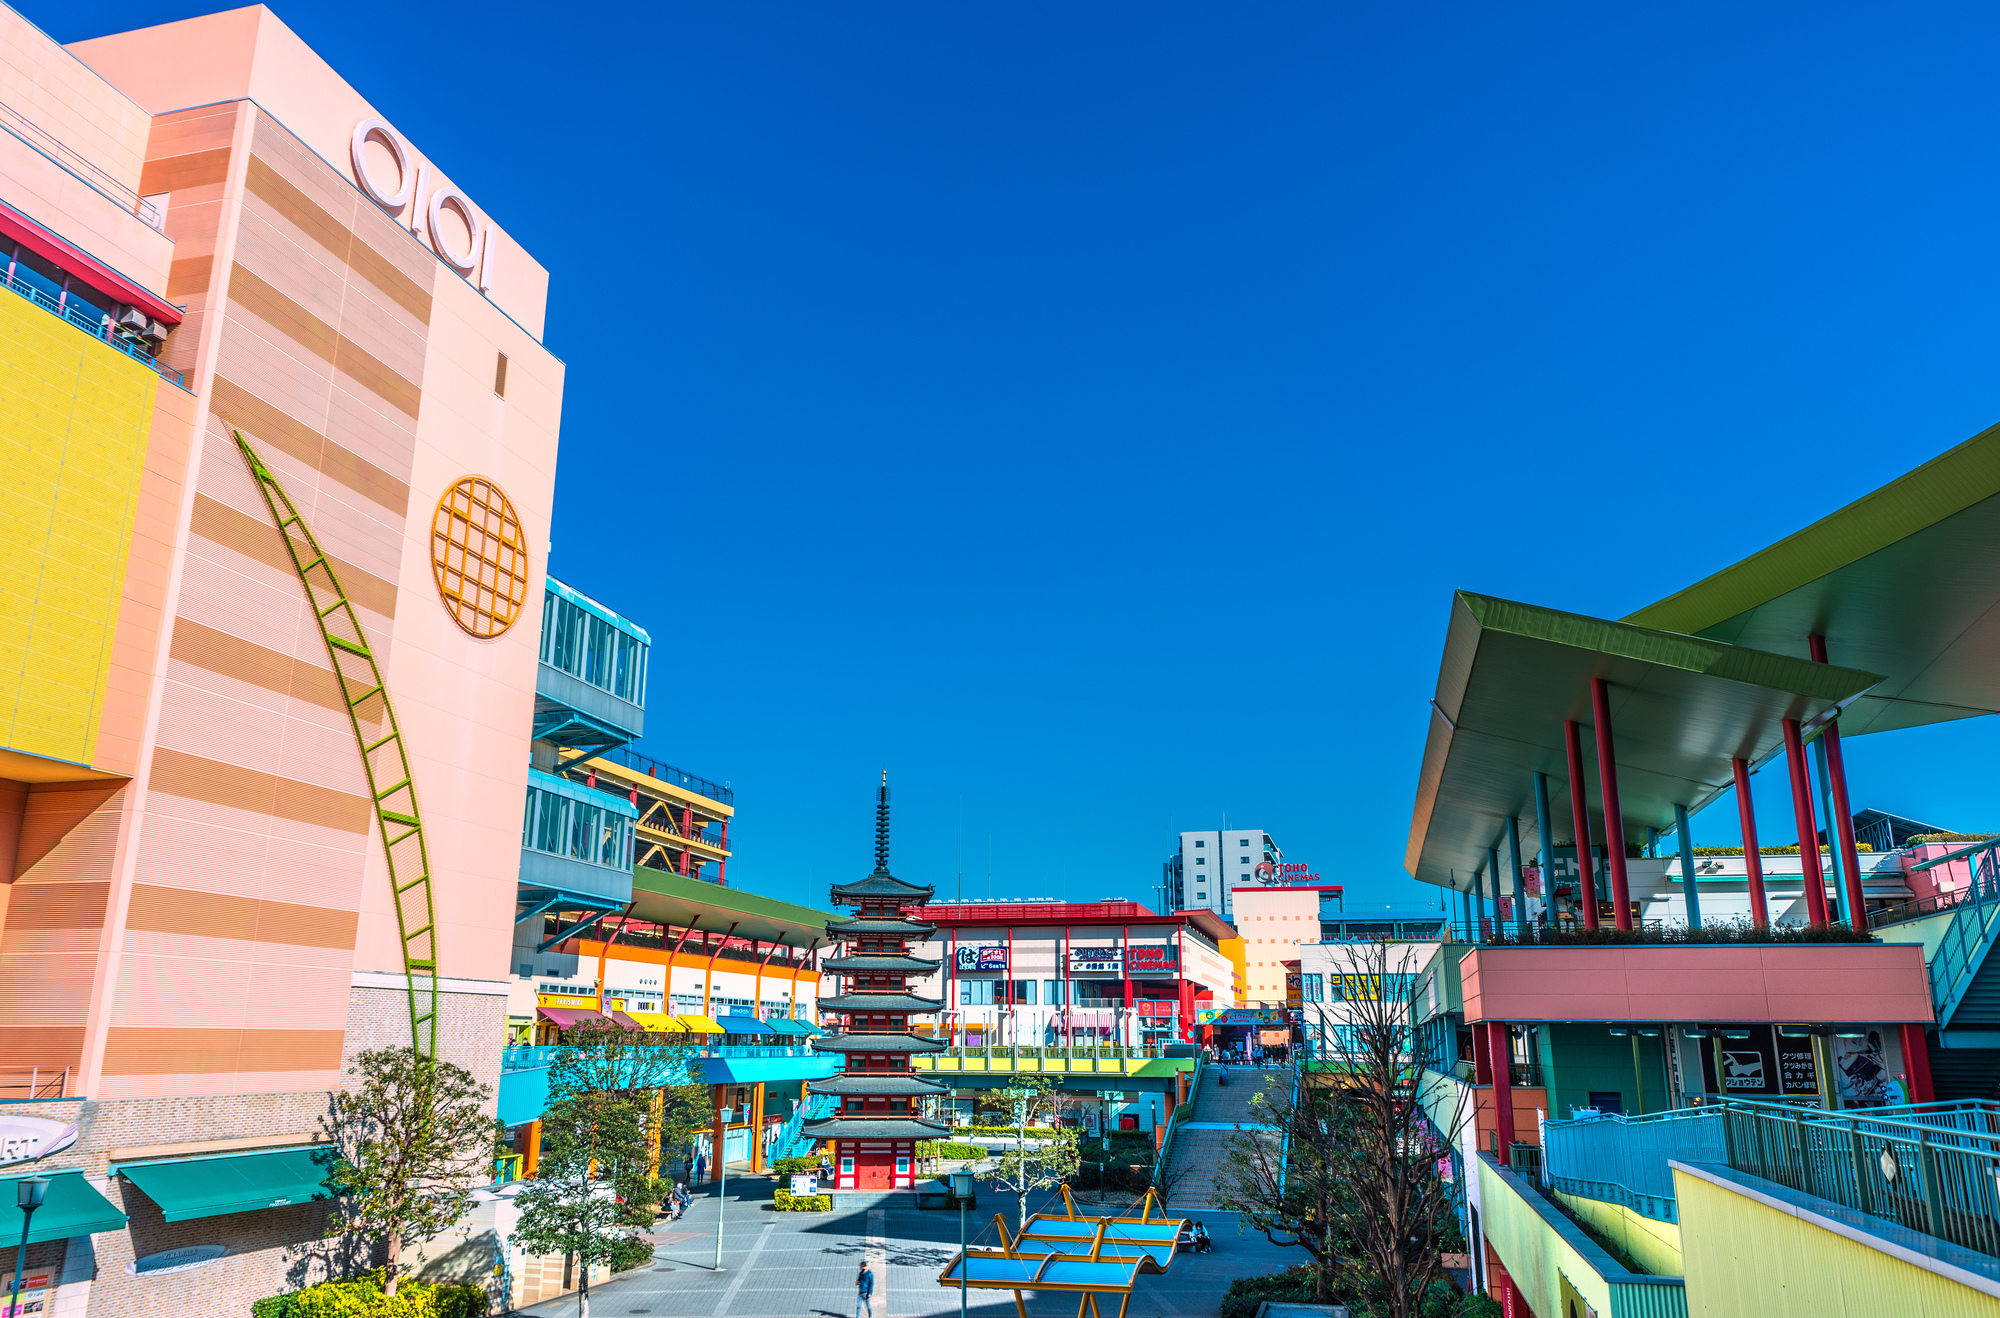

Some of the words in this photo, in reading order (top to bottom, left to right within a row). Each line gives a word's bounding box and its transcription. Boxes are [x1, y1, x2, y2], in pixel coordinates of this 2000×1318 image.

[1278, 863, 1308, 873] TOHO
[1278, 873, 1320, 882] CINEMAS
[1074, 947, 1118, 957] OUTBACK
[1130, 948, 1164, 960] TOHO
[1129, 960, 1178, 970] CINEMAS
[556, 997, 571, 1006] PARIS
[1782, 1052, 1813, 1060] クツ修理
[1725, 1078, 1764, 1087] ツショウテン
[142, 1261, 175, 1276] FOOD
[177, 1252, 216, 1270] COURT
